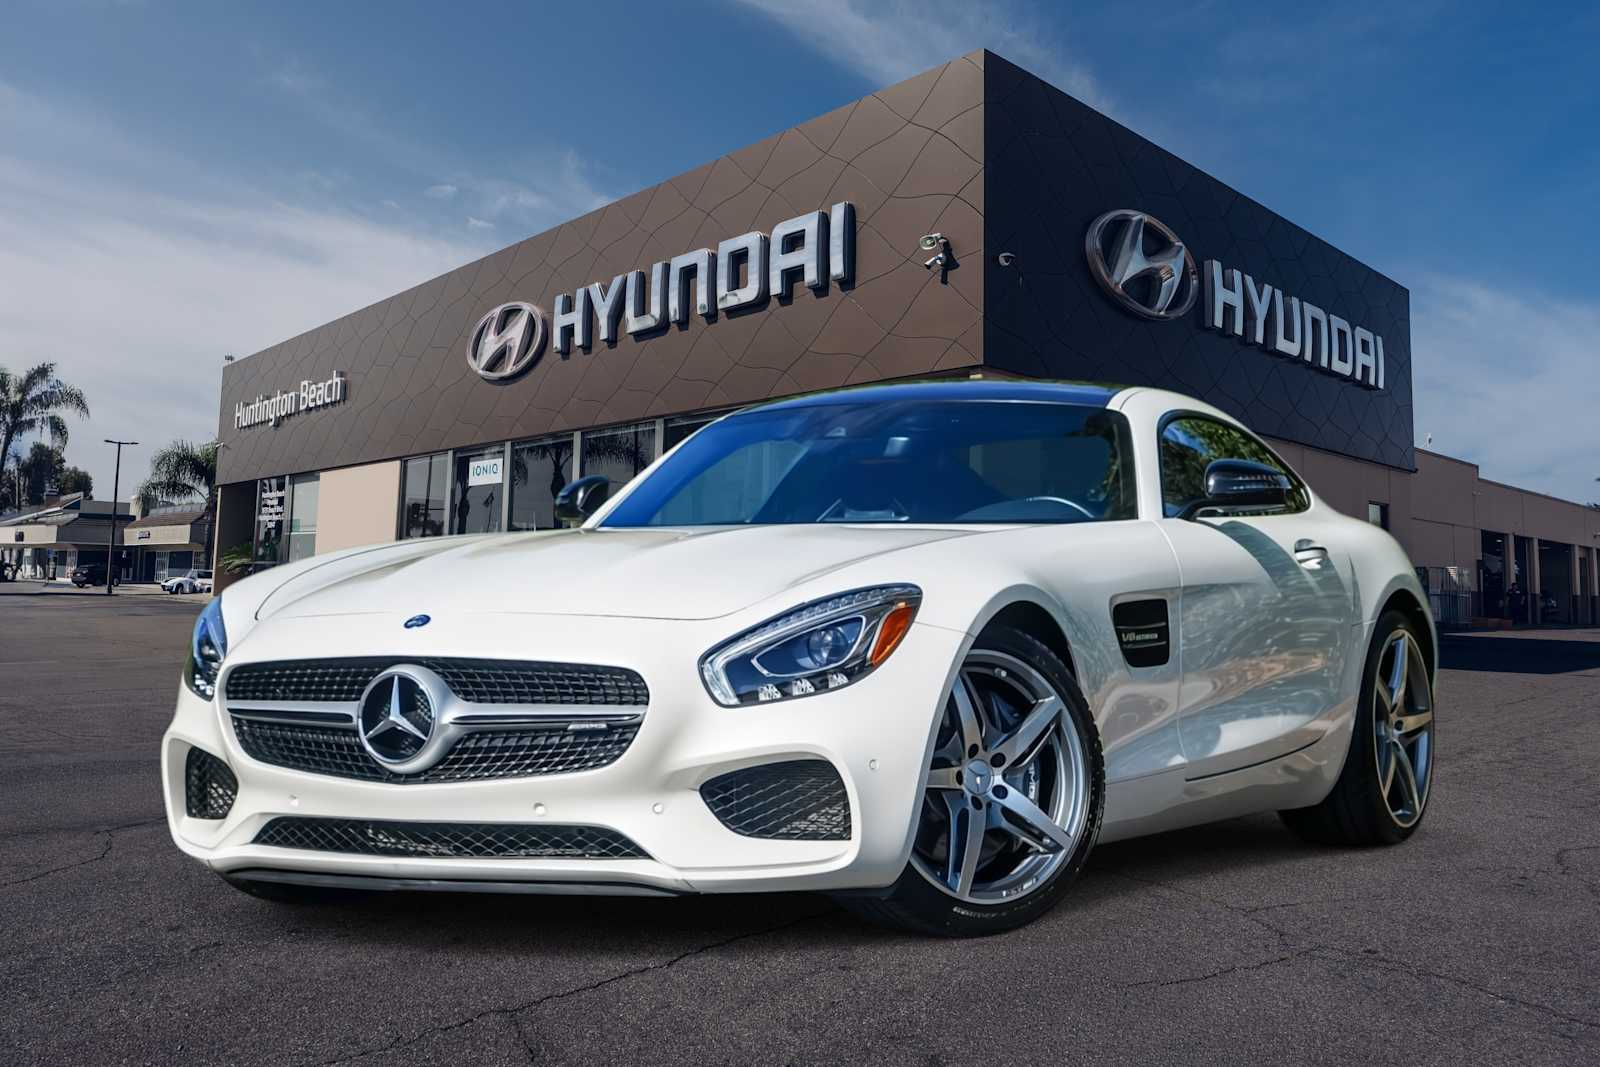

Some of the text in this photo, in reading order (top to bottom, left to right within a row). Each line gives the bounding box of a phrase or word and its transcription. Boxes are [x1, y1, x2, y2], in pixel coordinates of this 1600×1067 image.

[553, 201, 855, 354] HYUNDAI
[1206, 259, 1385, 389] HYUNDAI
[234, 370, 346, 429] Huntington Beach
